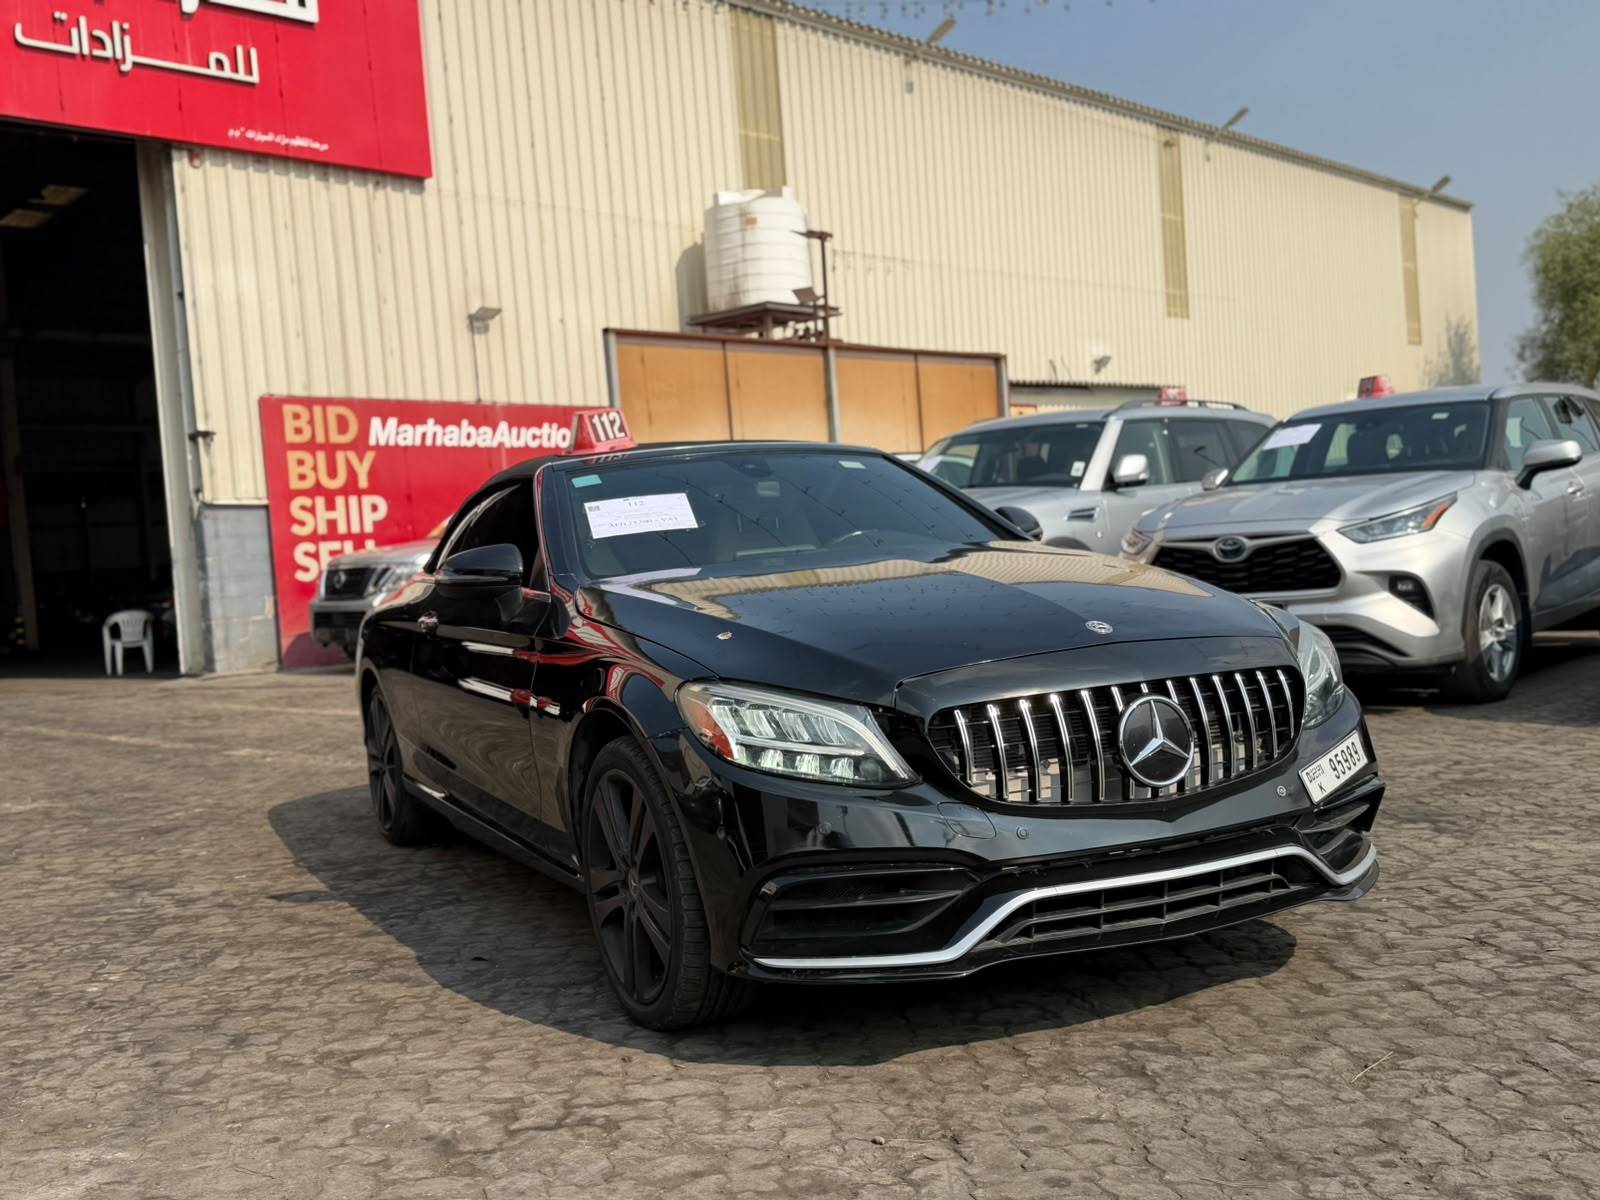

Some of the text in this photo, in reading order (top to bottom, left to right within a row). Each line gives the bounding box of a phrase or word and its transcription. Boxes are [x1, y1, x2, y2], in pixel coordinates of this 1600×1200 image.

[14, 11, 260, 84] للمزادات
[282, 404, 359, 444] BID
[591, 412, 626, 443] 112
[286, 450, 376, 491] BUY
[289, 495, 388, 537] SHIP
[293, 539, 377, 583] SE
[1328, 741, 1361, 780] 95989
[1317, 782, 1327, 795] K
